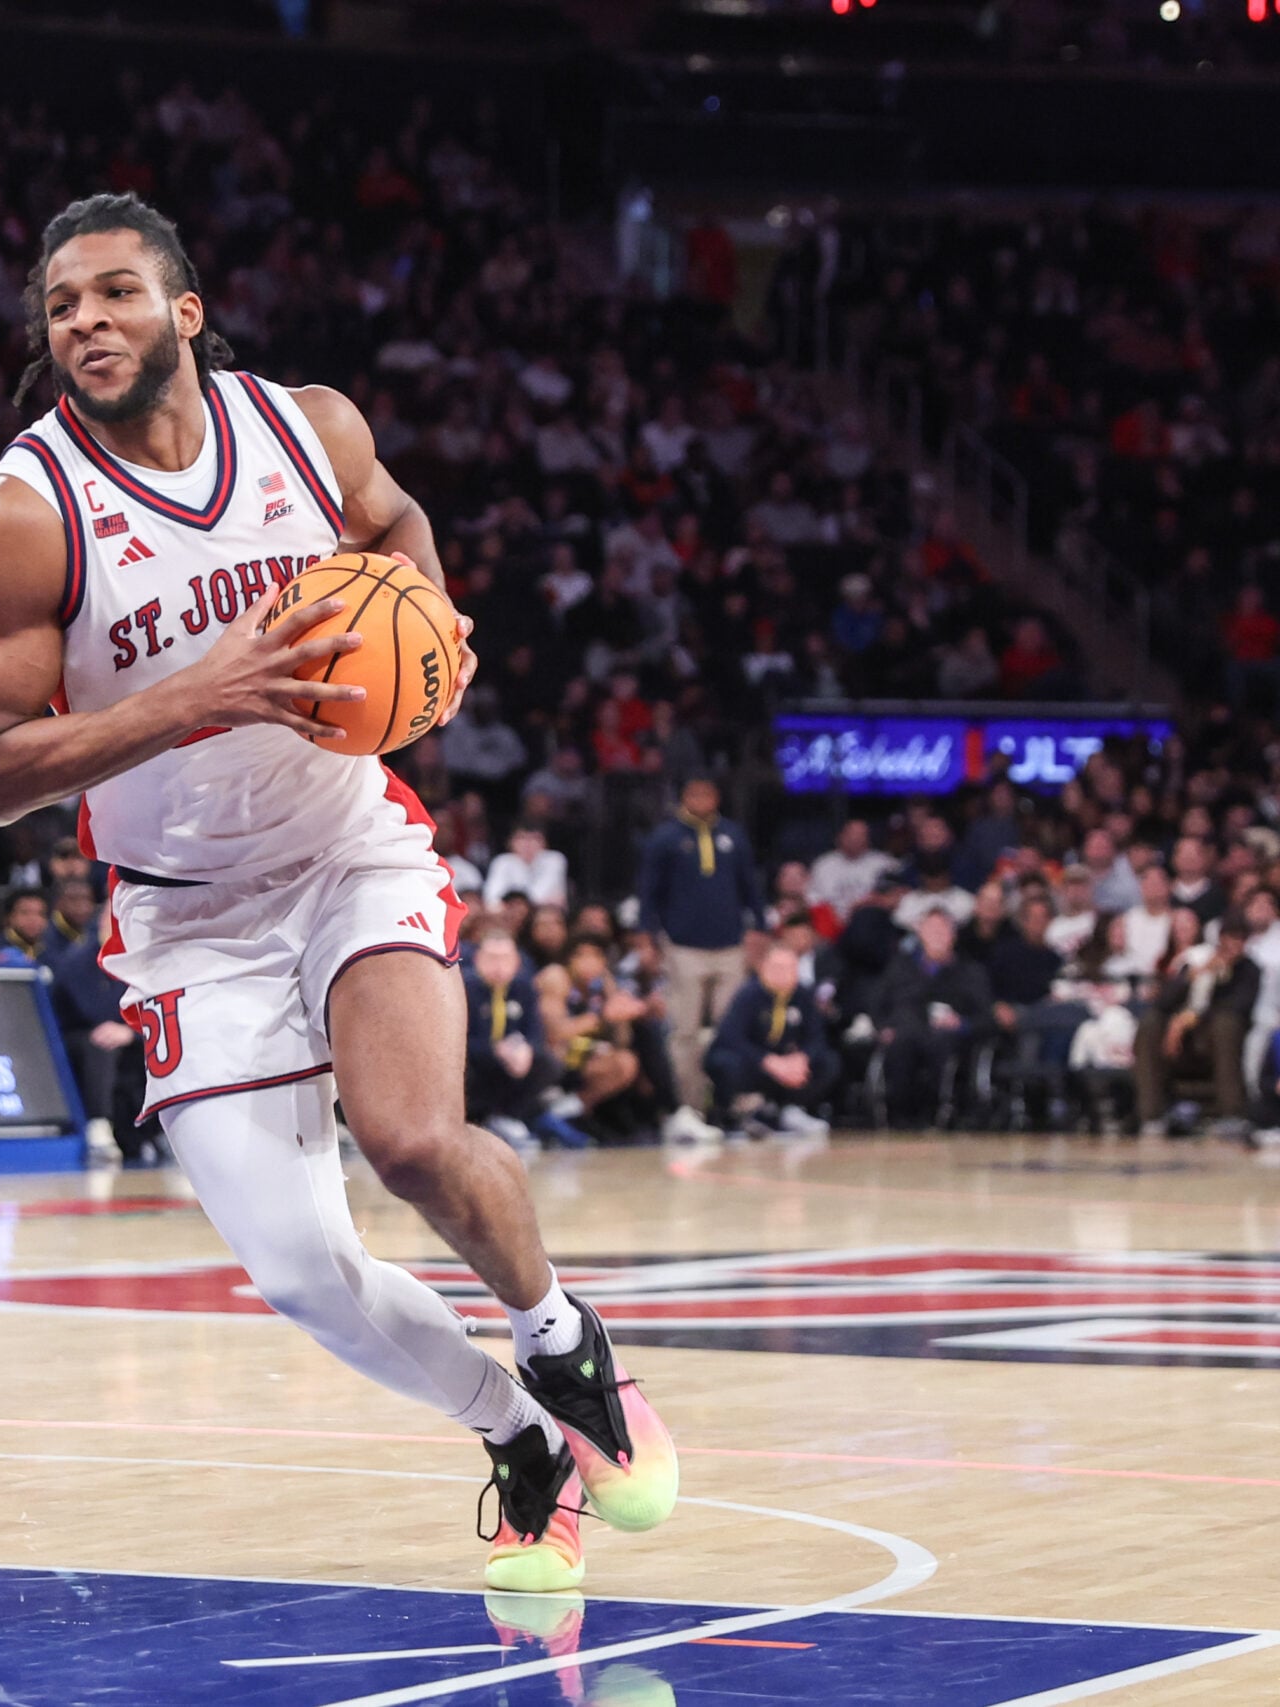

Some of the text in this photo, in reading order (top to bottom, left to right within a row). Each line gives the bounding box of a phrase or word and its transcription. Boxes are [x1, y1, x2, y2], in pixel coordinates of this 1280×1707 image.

[83, 480, 105, 512] C
[264, 503, 294, 521] EAST
[265, 498, 286, 512] BIG
[109, 597, 174, 672] ST.
[399, 648, 440, 747] ilson
